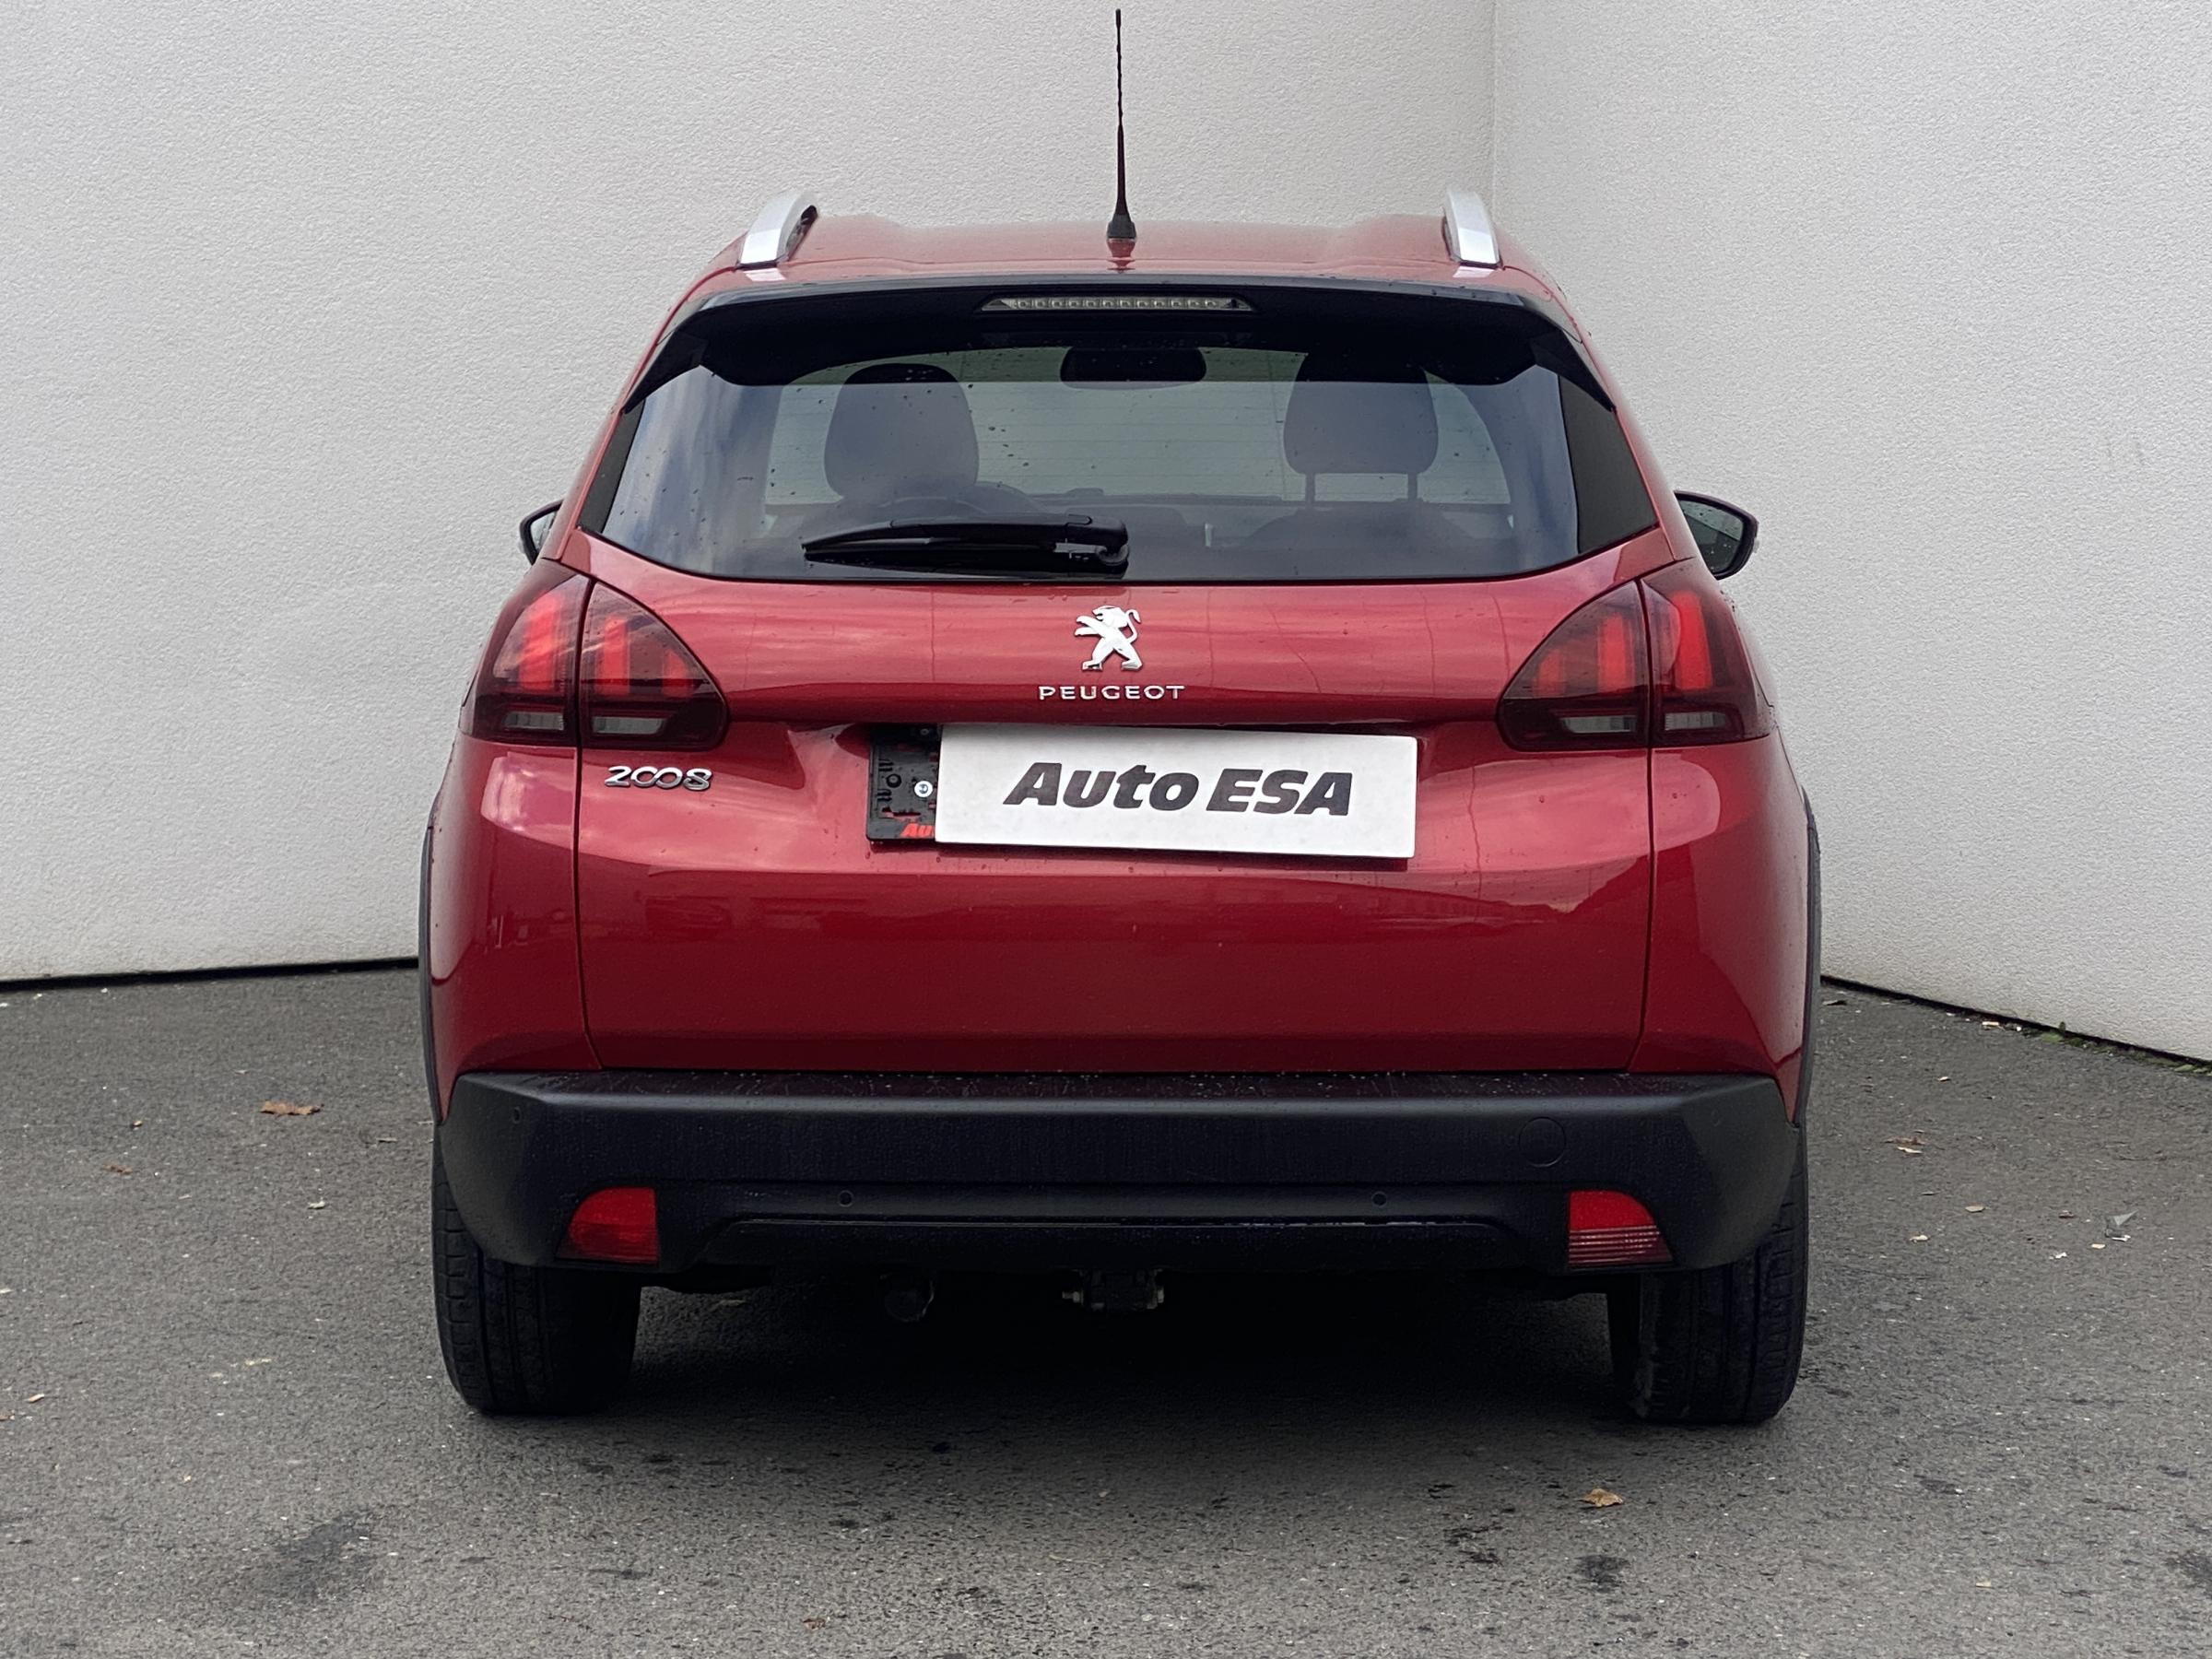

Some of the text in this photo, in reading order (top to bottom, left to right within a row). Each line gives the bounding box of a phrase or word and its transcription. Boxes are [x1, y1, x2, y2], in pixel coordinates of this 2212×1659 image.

[1038, 684, 1186, 701] PEUGEOT
[604, 765, 713, 792] 2008
[1002, 761, 1353, 817] Auto ESA
